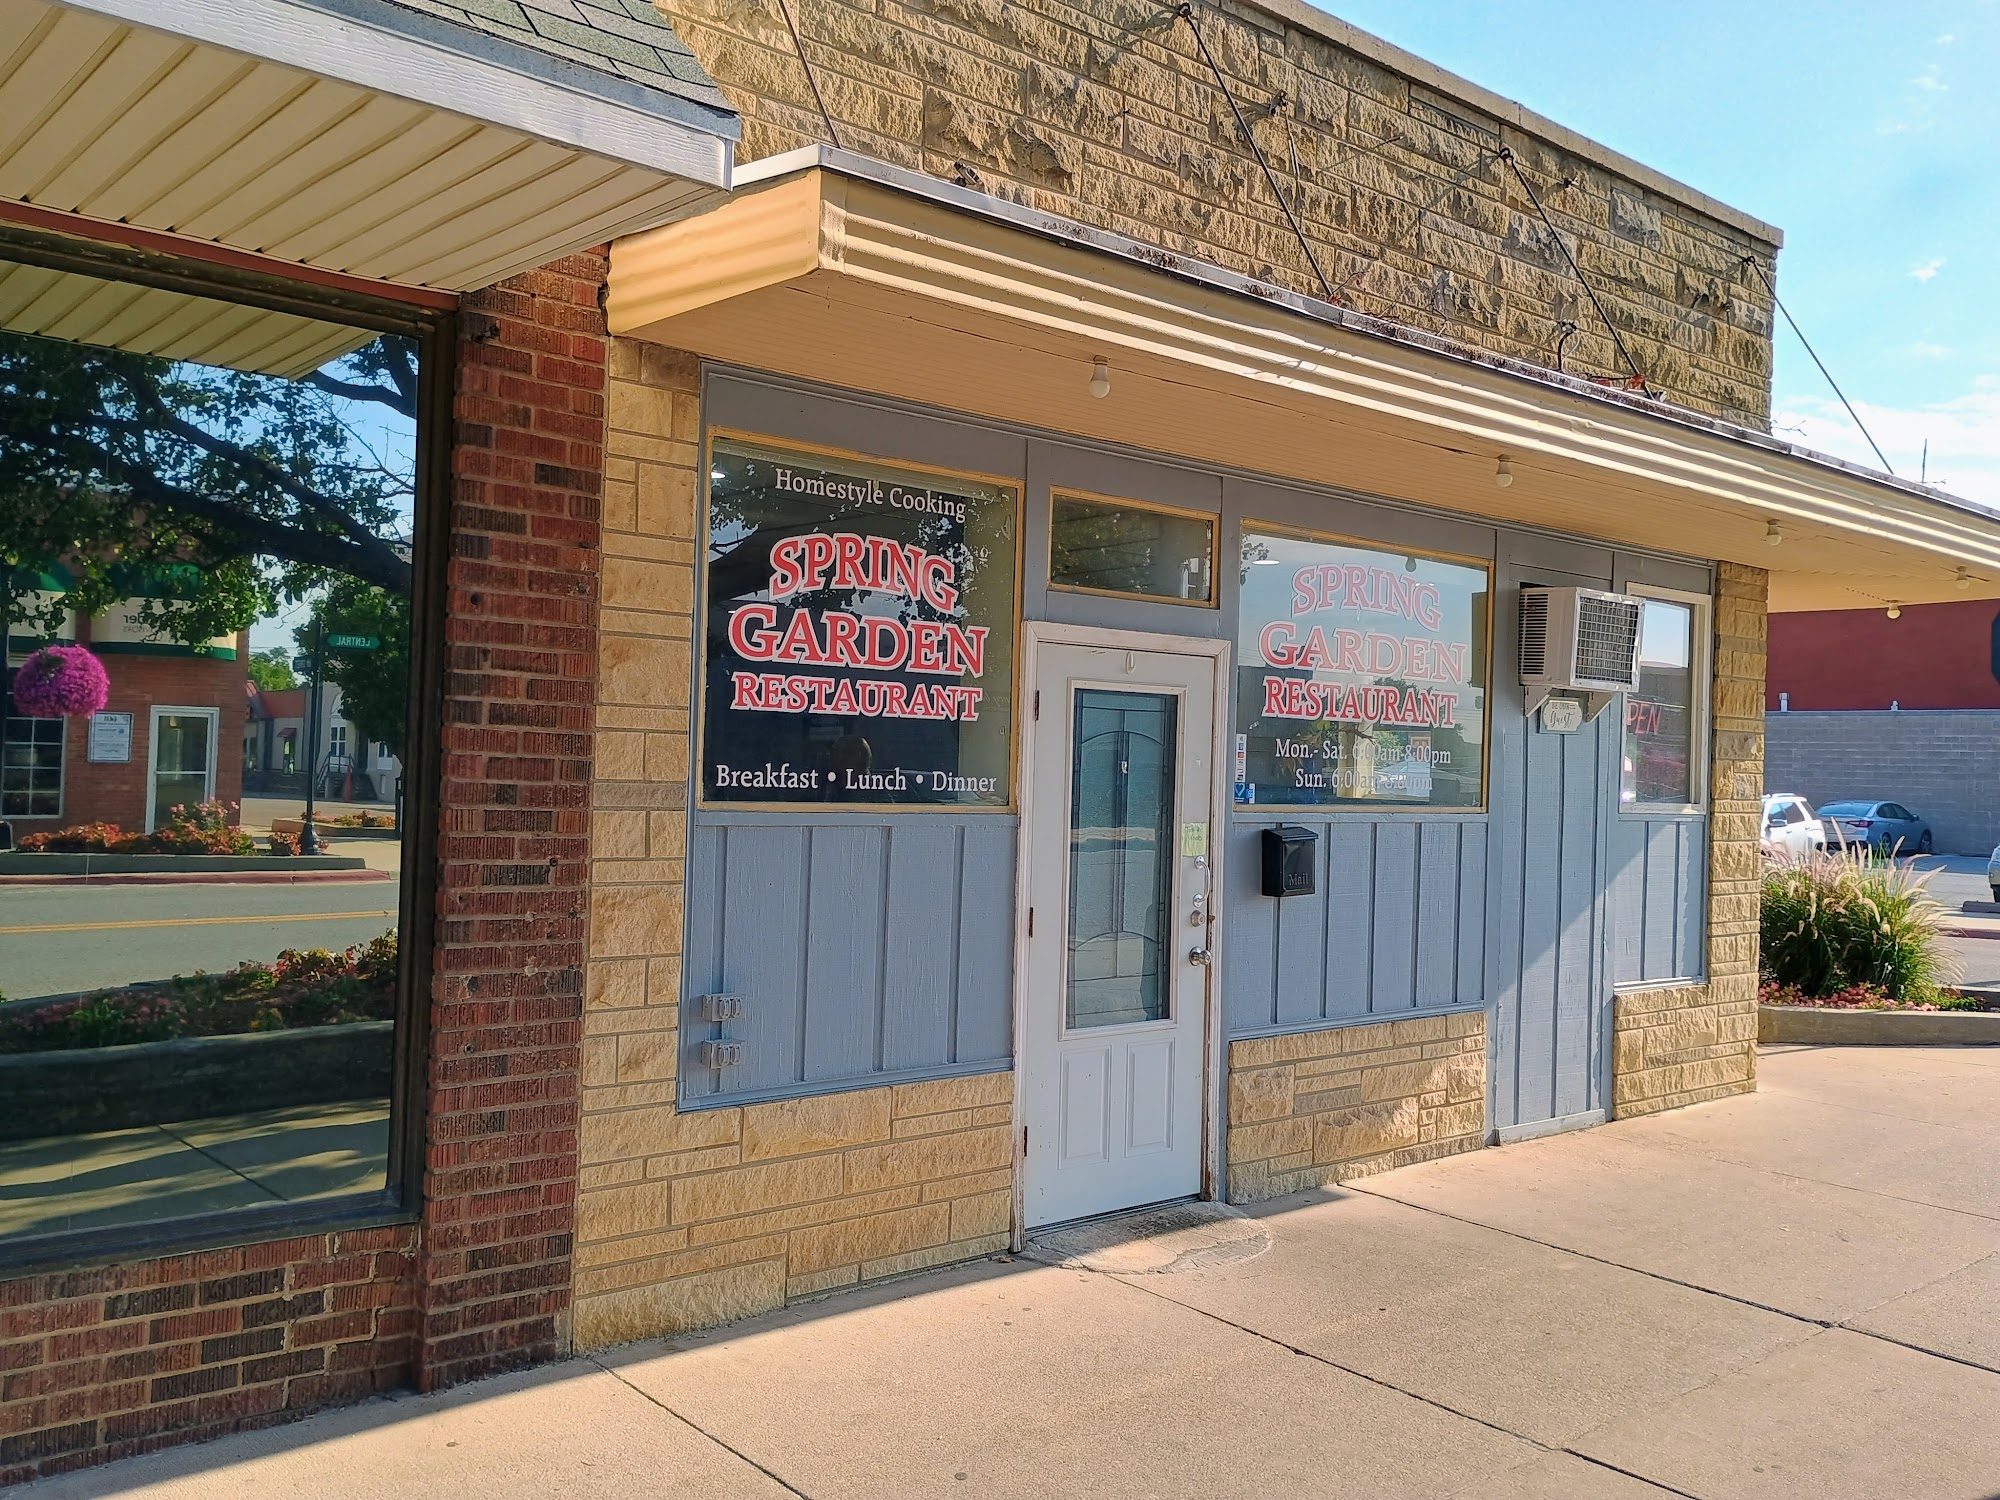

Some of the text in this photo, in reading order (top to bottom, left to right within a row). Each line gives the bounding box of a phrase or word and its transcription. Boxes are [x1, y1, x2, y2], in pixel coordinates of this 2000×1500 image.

[775, 468, 967, 524] Homestyle Cooking
[768, 533, 959, 615] SPRING
[1291, 563, 1442, 632] SPRING
[728, 603, 990, 679] GARDEN
[1258, 620, 1467, 686] GARDEN
[730, 671, 984, 722] RESTAURANT
[1262, 676, 1459, 729] RESTAURANT
[1626, 702, 1663, 735] PEN
[715, 763, 997, 792] Breakfast Lunch Dinner
[1295, 768, 1327, 788] Sun.
[1288, 872, 1309, 886] Mail
